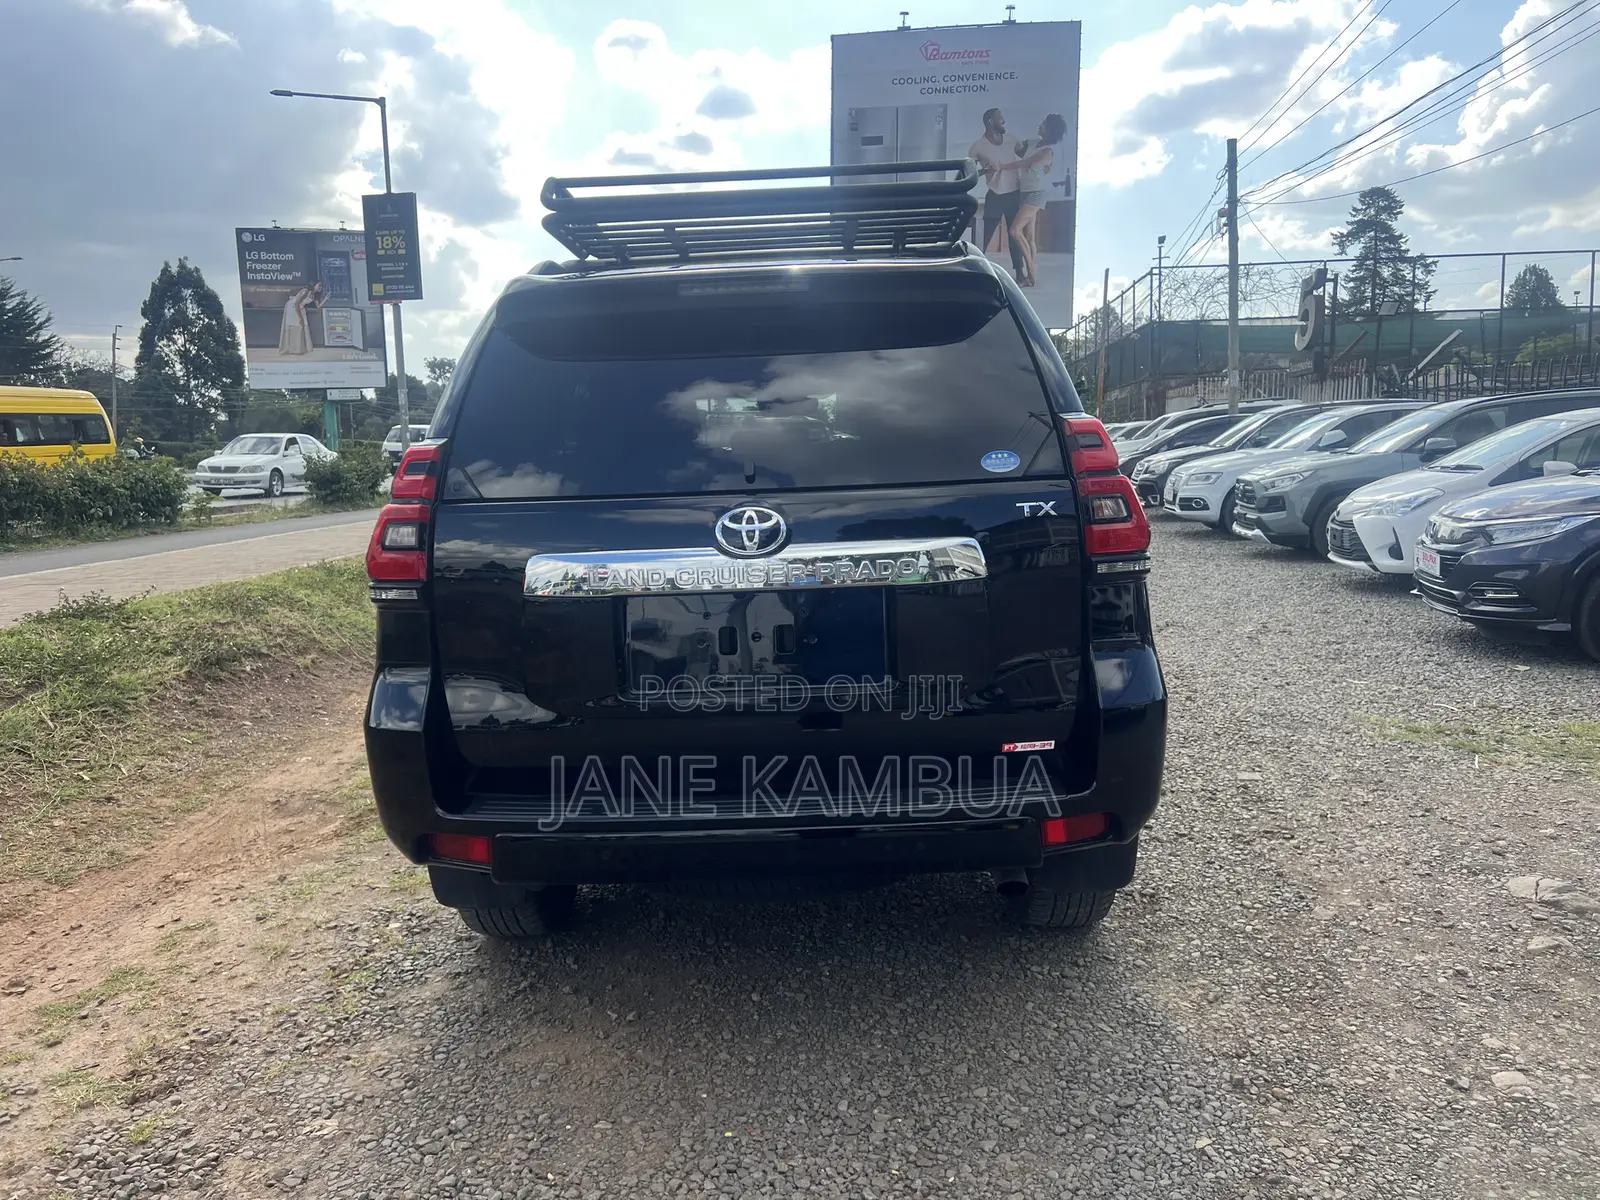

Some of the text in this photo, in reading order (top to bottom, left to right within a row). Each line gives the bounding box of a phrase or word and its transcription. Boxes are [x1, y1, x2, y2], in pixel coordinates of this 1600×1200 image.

[891, 71, 1018, 85] COOLING. CONVENIENCE.
[919, 84, 989, 95] CONNECTION.
[253, 234, 266, 242] LG
[375, 235, 406, 249] 18%
[245, 251, 295, 261] LG Bottom
[246, 261, 282, 270] Freezer
[1015, 500, 1058, 517] TX
[587, 557, 920, 589] LAND CRUISER PRADO
